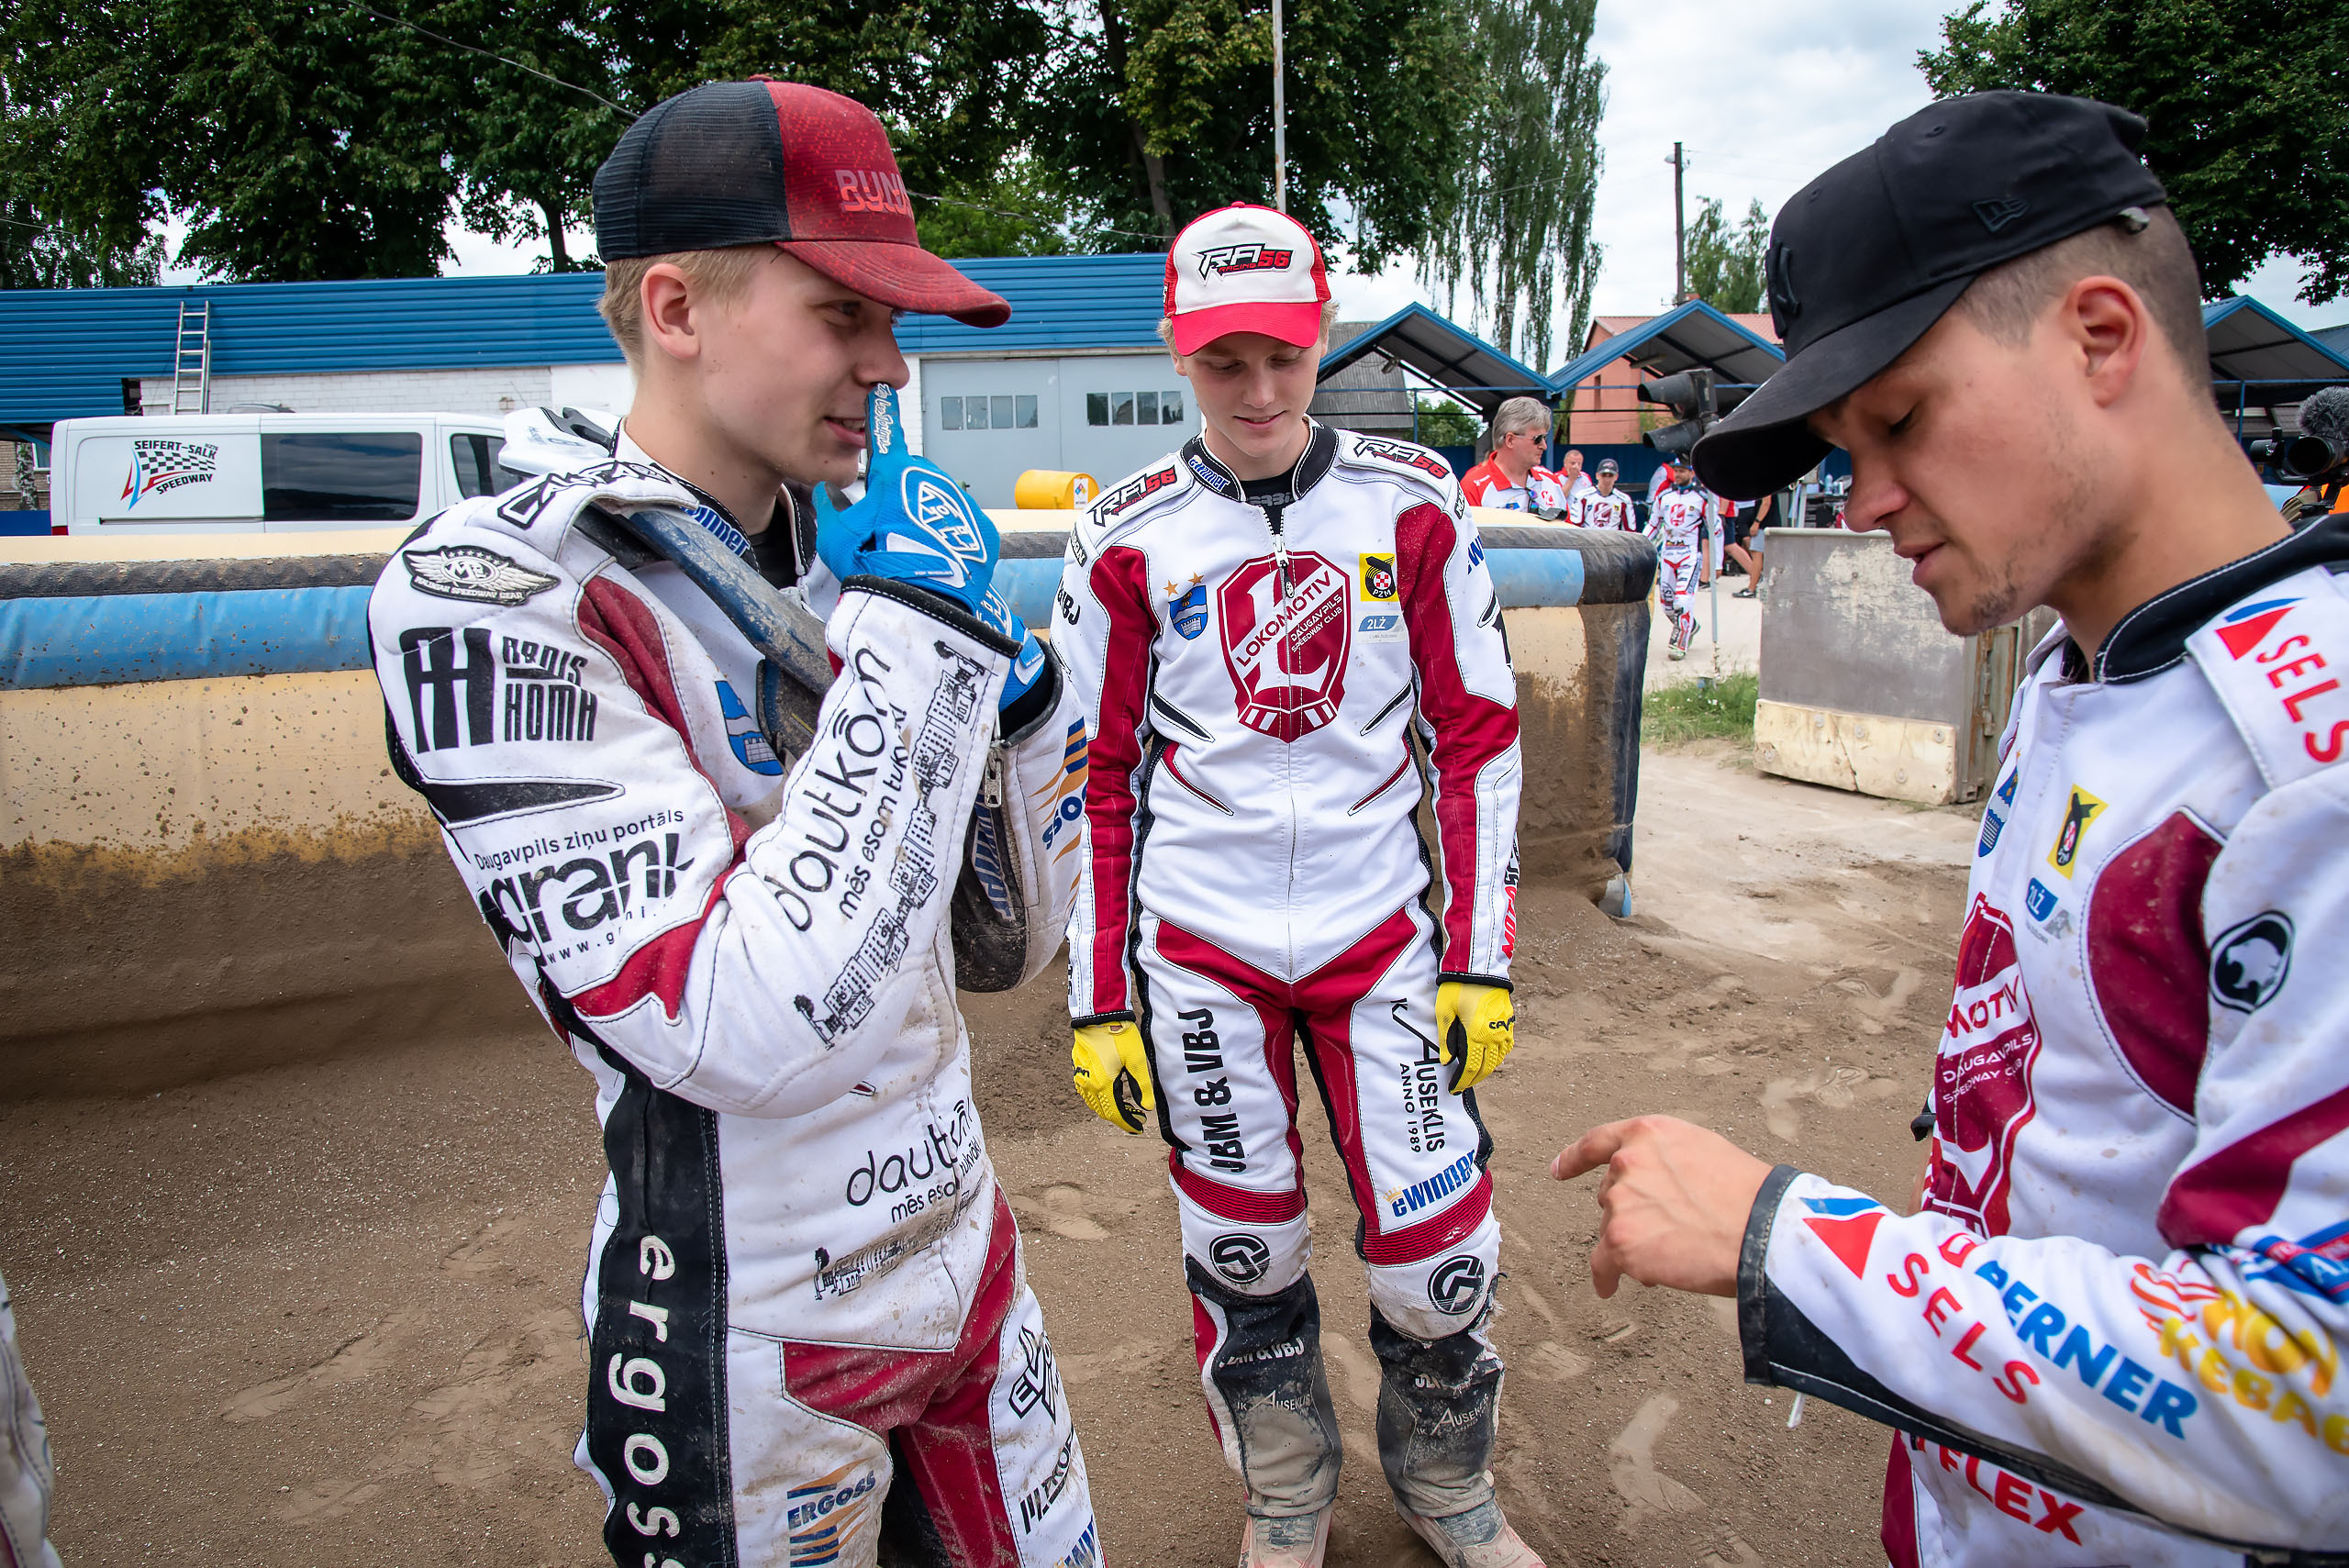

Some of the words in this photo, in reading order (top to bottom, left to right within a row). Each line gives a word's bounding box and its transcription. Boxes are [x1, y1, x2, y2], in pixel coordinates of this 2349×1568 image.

[1219, 262, 1257, 272] RACING
[134, 439, 217, 461] SEIFERT-SALK
[155, 473, 213, 495] SPEEDWAY
[1290, 594, 1342, 642] DAUGAVPILS
[1372, 588, 1392, 598] PZM
[1236, 570, 1330, 667] LOKOMOTIV
[1291, 623, 1324, 653] SPEEDWAY
[1323, 606, 1342, 625] CLUB
[2255, 634, 2349, 763] SELS
[473, 838, 560, 871] Daugavpils
[565, 829, 607, 851] ziņu
[614, 808, 684, 842] portāls
[863, 804, 899, 863] esam
[1177, 1007, 1224, 1074] VBJ
[1943, 1032, 2033, 1084] DAUGAVPILS
[1194, 1075, 1232, 1106] &
[1399, 1062, 1416, 1114] ANNO
[1942, 1069, 2001, 1104] SPEEDWAY
[1407, 1120, 1421, 1153] 1989
[891, 1193, 926, 1224] mēs
[928, 1177, 961, 1205] esa
[1887, 1252, 2041, 1406] SELS
[1975, 1260, 2199, 1440] BERNER
[786, 1469, 876, 1530] ERGOSS
